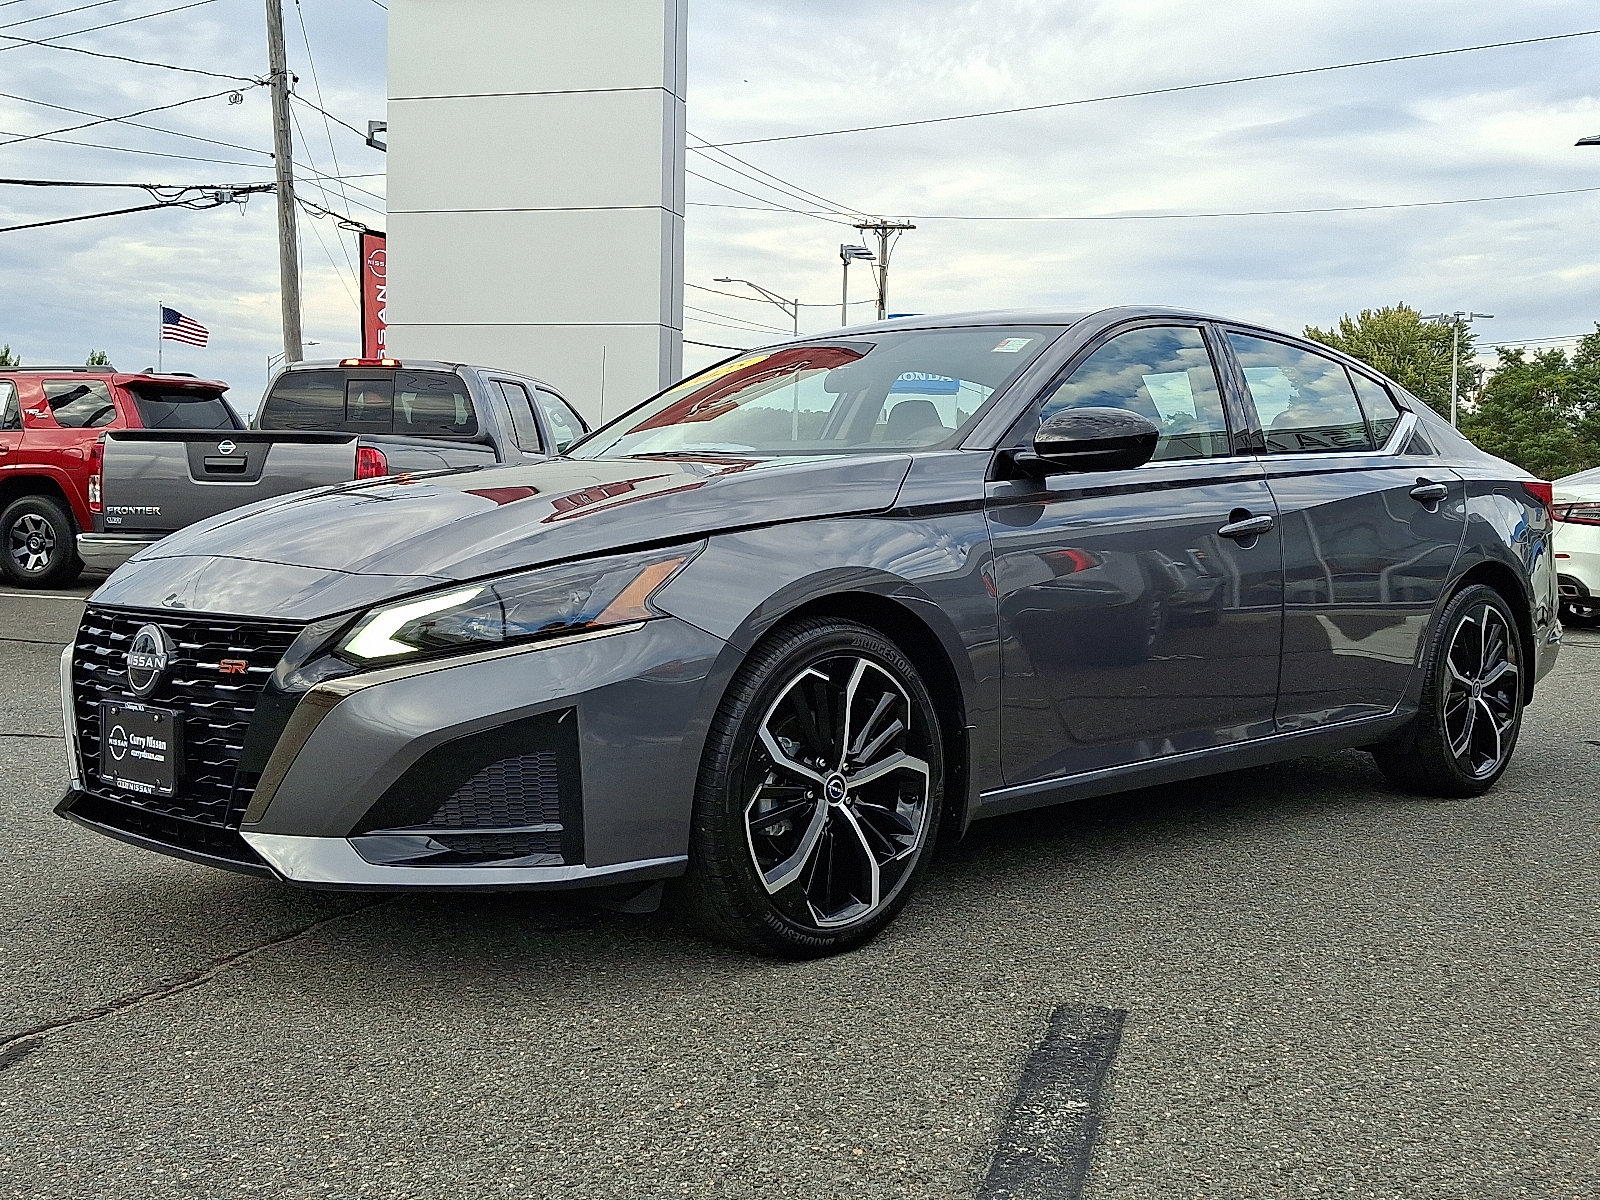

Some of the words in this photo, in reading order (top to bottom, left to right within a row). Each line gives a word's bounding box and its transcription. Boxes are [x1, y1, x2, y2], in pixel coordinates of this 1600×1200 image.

[106, 506, 161, 515] FRONTIER
[128, 654, 165, 668] NISSAN
[850, 637, 918, 680] BRIDGESTONE
[219, 659, 248, 674] SR
[108, 738, 128, 747] NISSAN
[130, 734, 145, 748] Curry
[146, 736, 166, 750] Nissan
